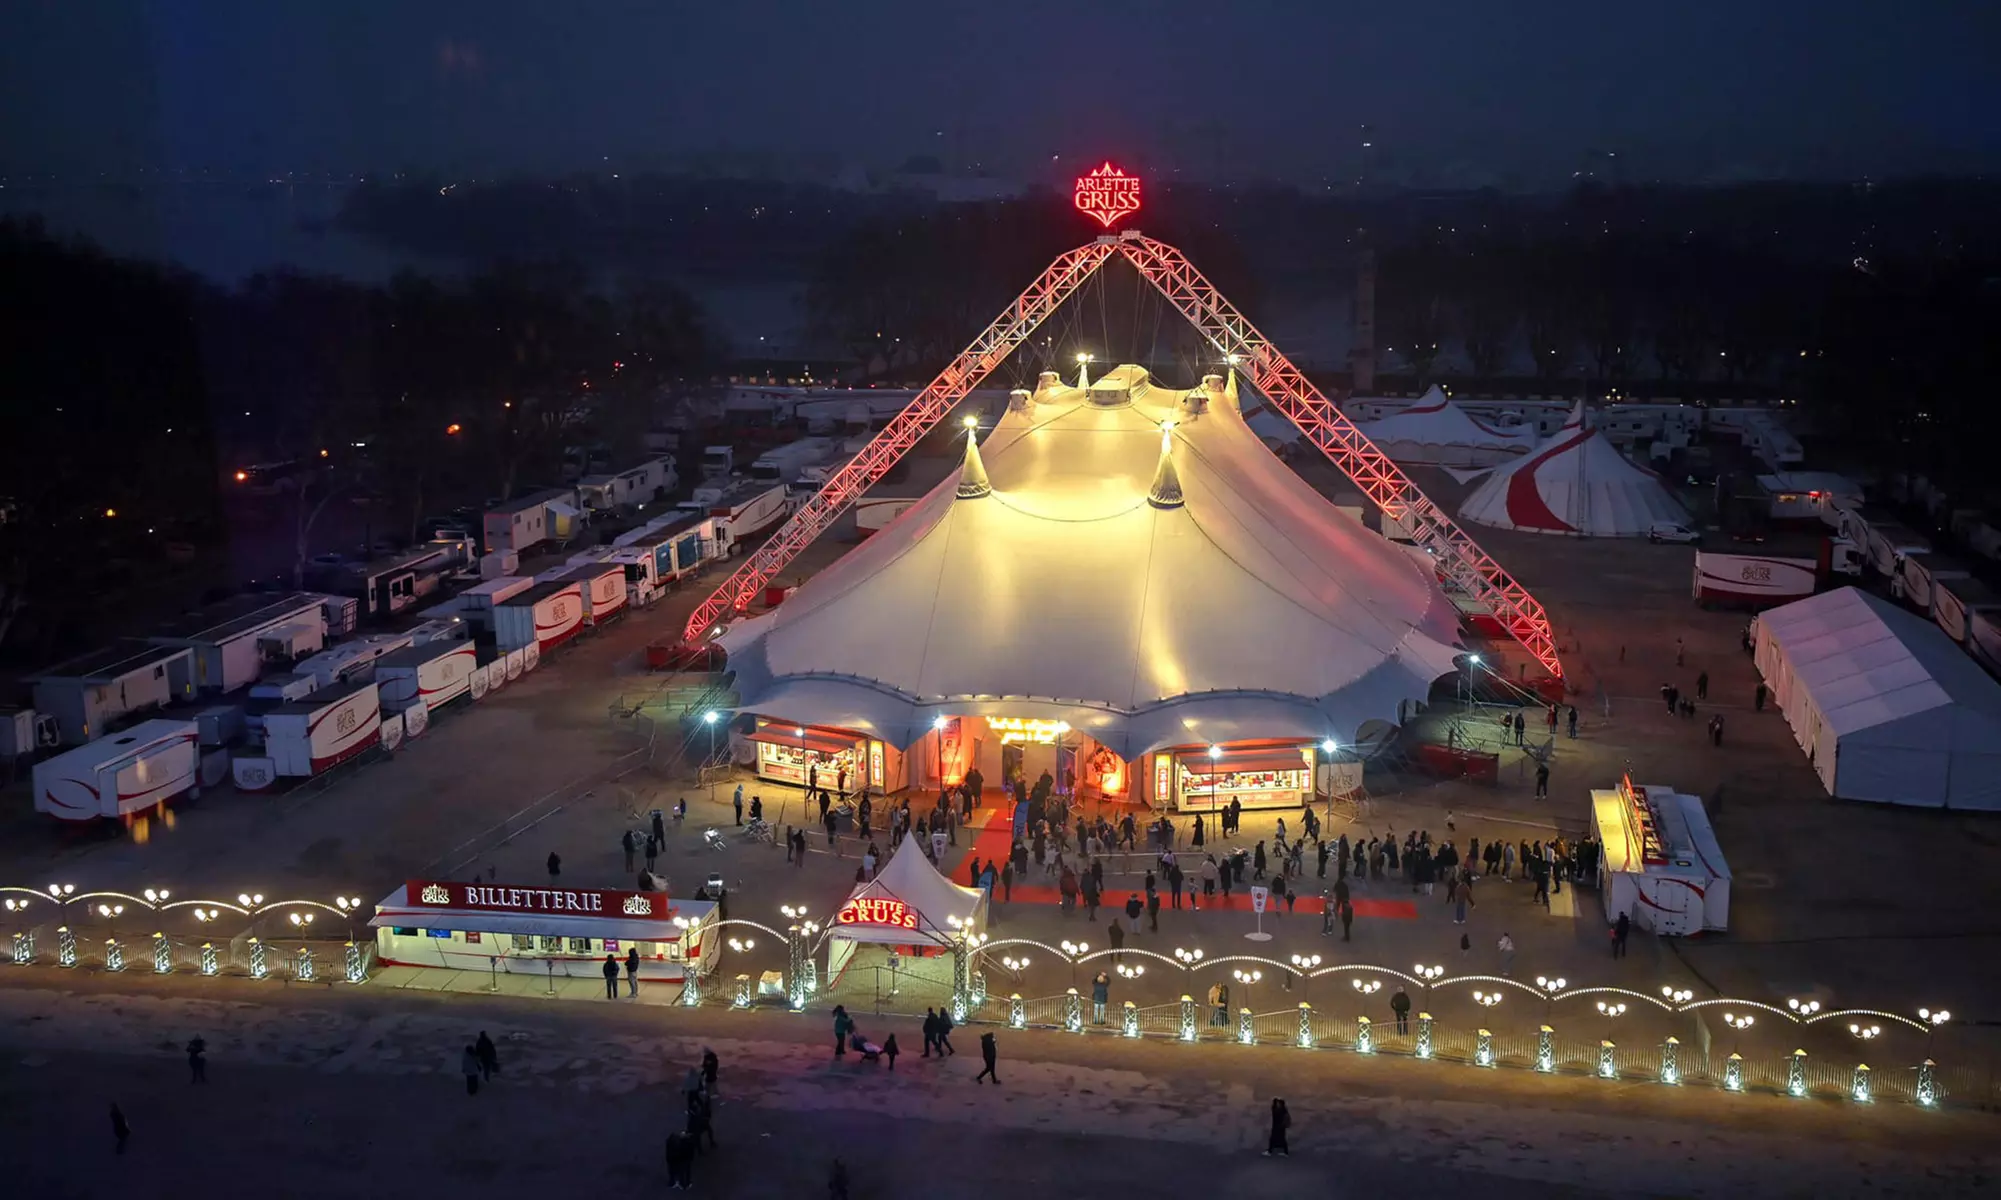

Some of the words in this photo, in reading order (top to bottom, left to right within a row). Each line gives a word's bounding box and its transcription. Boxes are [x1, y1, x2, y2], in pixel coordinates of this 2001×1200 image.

[1076, 178, 1140, 191] ARLETTE
[1075, 191, 1140, 210] GRUSS
[422, 893, 450, 904] GRUSS
[465, 886, 602, 911] BILLETTERIE
[623, 903, 652, 915] GRUSS
[850, 899, 904, 912] ARLETTE
[839, 909, 916, 928] GRUSS
